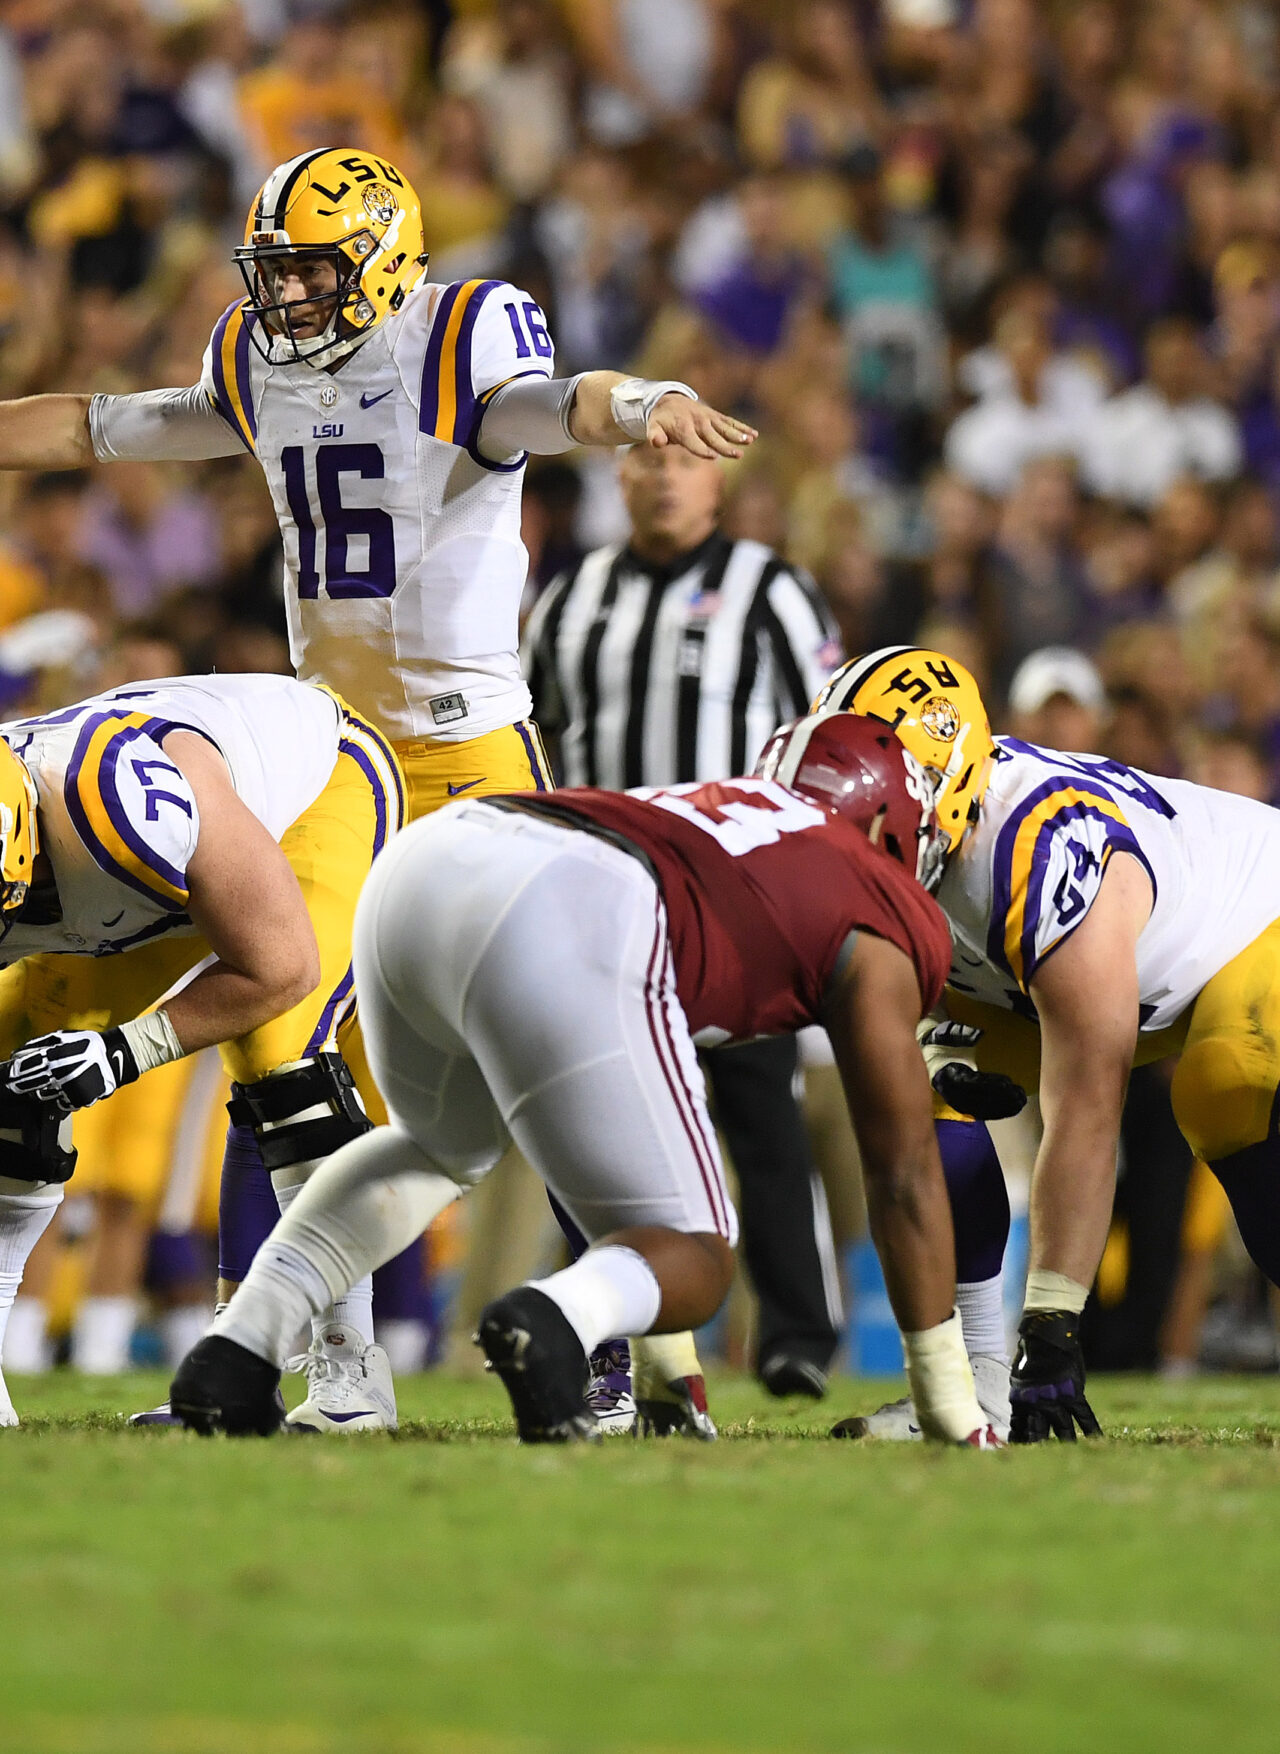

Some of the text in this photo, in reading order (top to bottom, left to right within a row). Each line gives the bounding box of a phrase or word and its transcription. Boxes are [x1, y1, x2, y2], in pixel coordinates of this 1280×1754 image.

[310, 157, 404, 204] LSU
[504, 302, 552, 358] 16
[313, 424, 344, 438] LSU
[281, 443, 397, 599] 16
[439, 700, 453, 709] 42
[866, 660, 960, 731] LSU
[131, 759, 193, 821] 77
